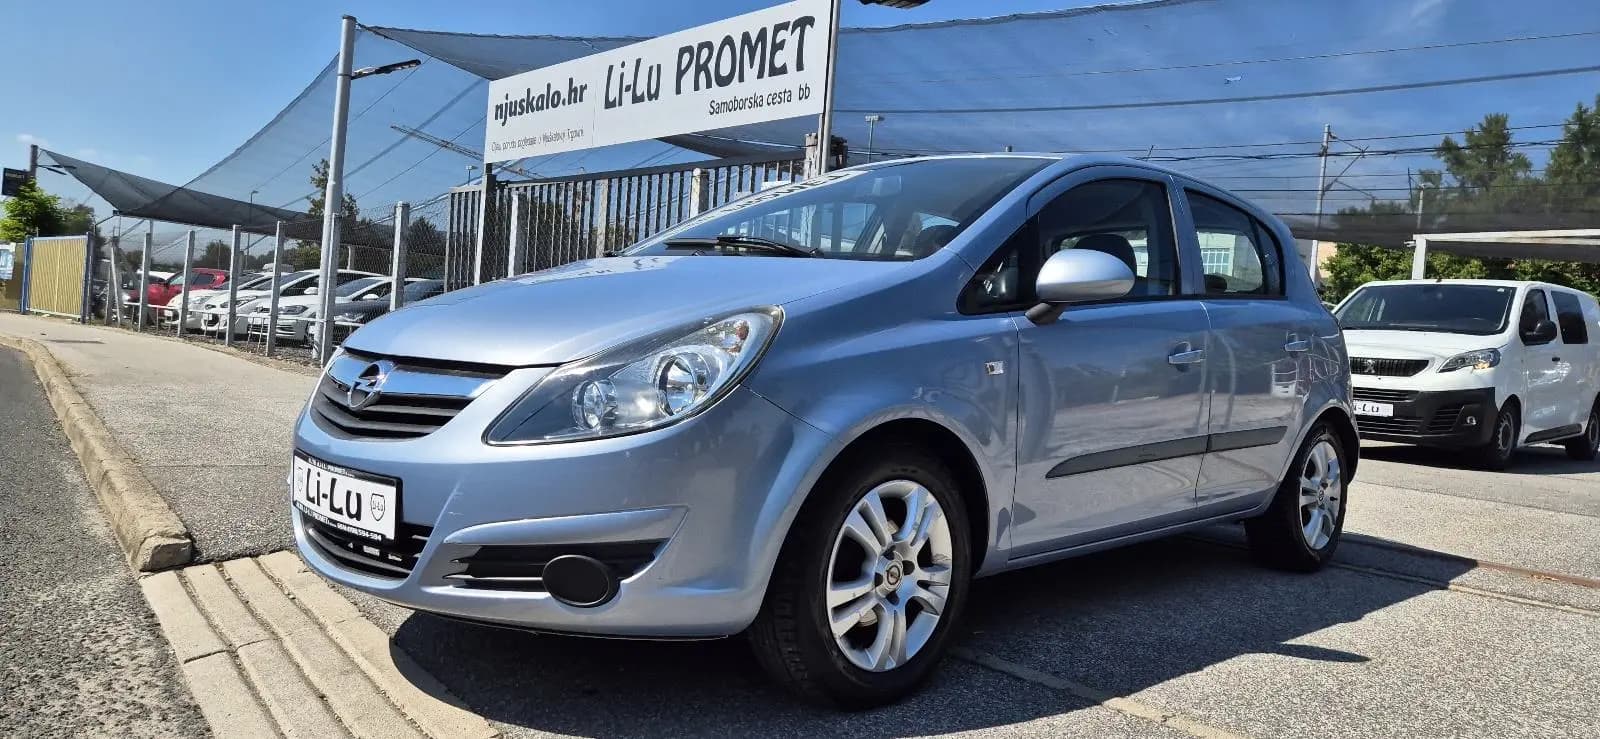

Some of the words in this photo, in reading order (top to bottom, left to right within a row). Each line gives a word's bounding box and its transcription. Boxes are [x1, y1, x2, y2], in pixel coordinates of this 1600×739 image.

[604, 58, 662, 110] Li-Lu
[675, 15, 816, 96] PROMET
[494, 77, 588, 126] njuskalo.hr
[709, 97, 764, 116] Samoborska
[767, 91, 793, 107] cesta
[798, 84, 812, 101] bb
[306, 468, 361, 521] Li-Lu
